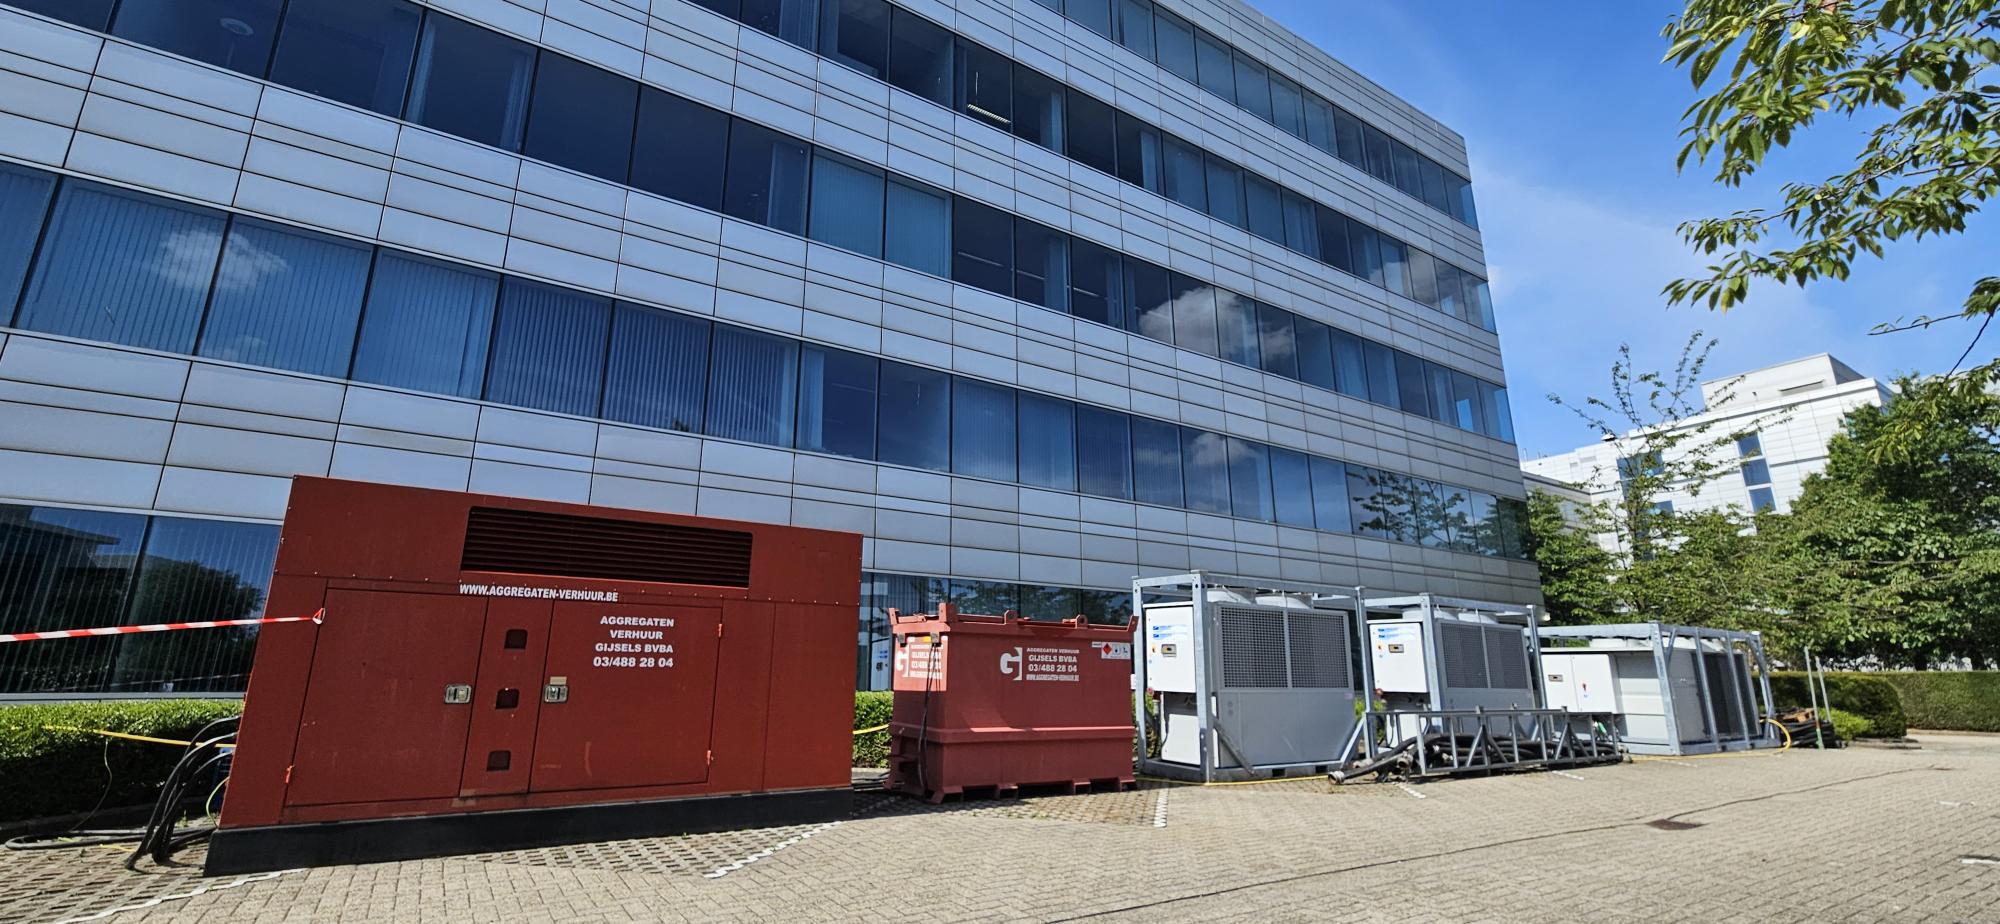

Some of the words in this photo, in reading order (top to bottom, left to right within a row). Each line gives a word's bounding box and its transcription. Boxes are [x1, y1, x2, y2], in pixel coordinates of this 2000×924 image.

[459, 584, 619, 602] WWW.AGGREGATEN-VERHUUR.BE
[600, 615, 675, 627] AGGREGATEN
[609, 629, 664, 640] VERHUUR
[595, 643, 642, 653] GIJSELS
[644, 644, 674, 653] BVBA
[593, 656, 636, 667] 03/488
[639, 657, 655, 668] 28
[658, 658, 674, 668] 04
[1028, 654, 1058, 662] GIJSELS
[1058, 655, 1078, 663] BVBA
[1028, 663, 1056, 672] 03/488
[1056, 664, 1067, 672] 28
[1067, 664, 1078, 673] 04
